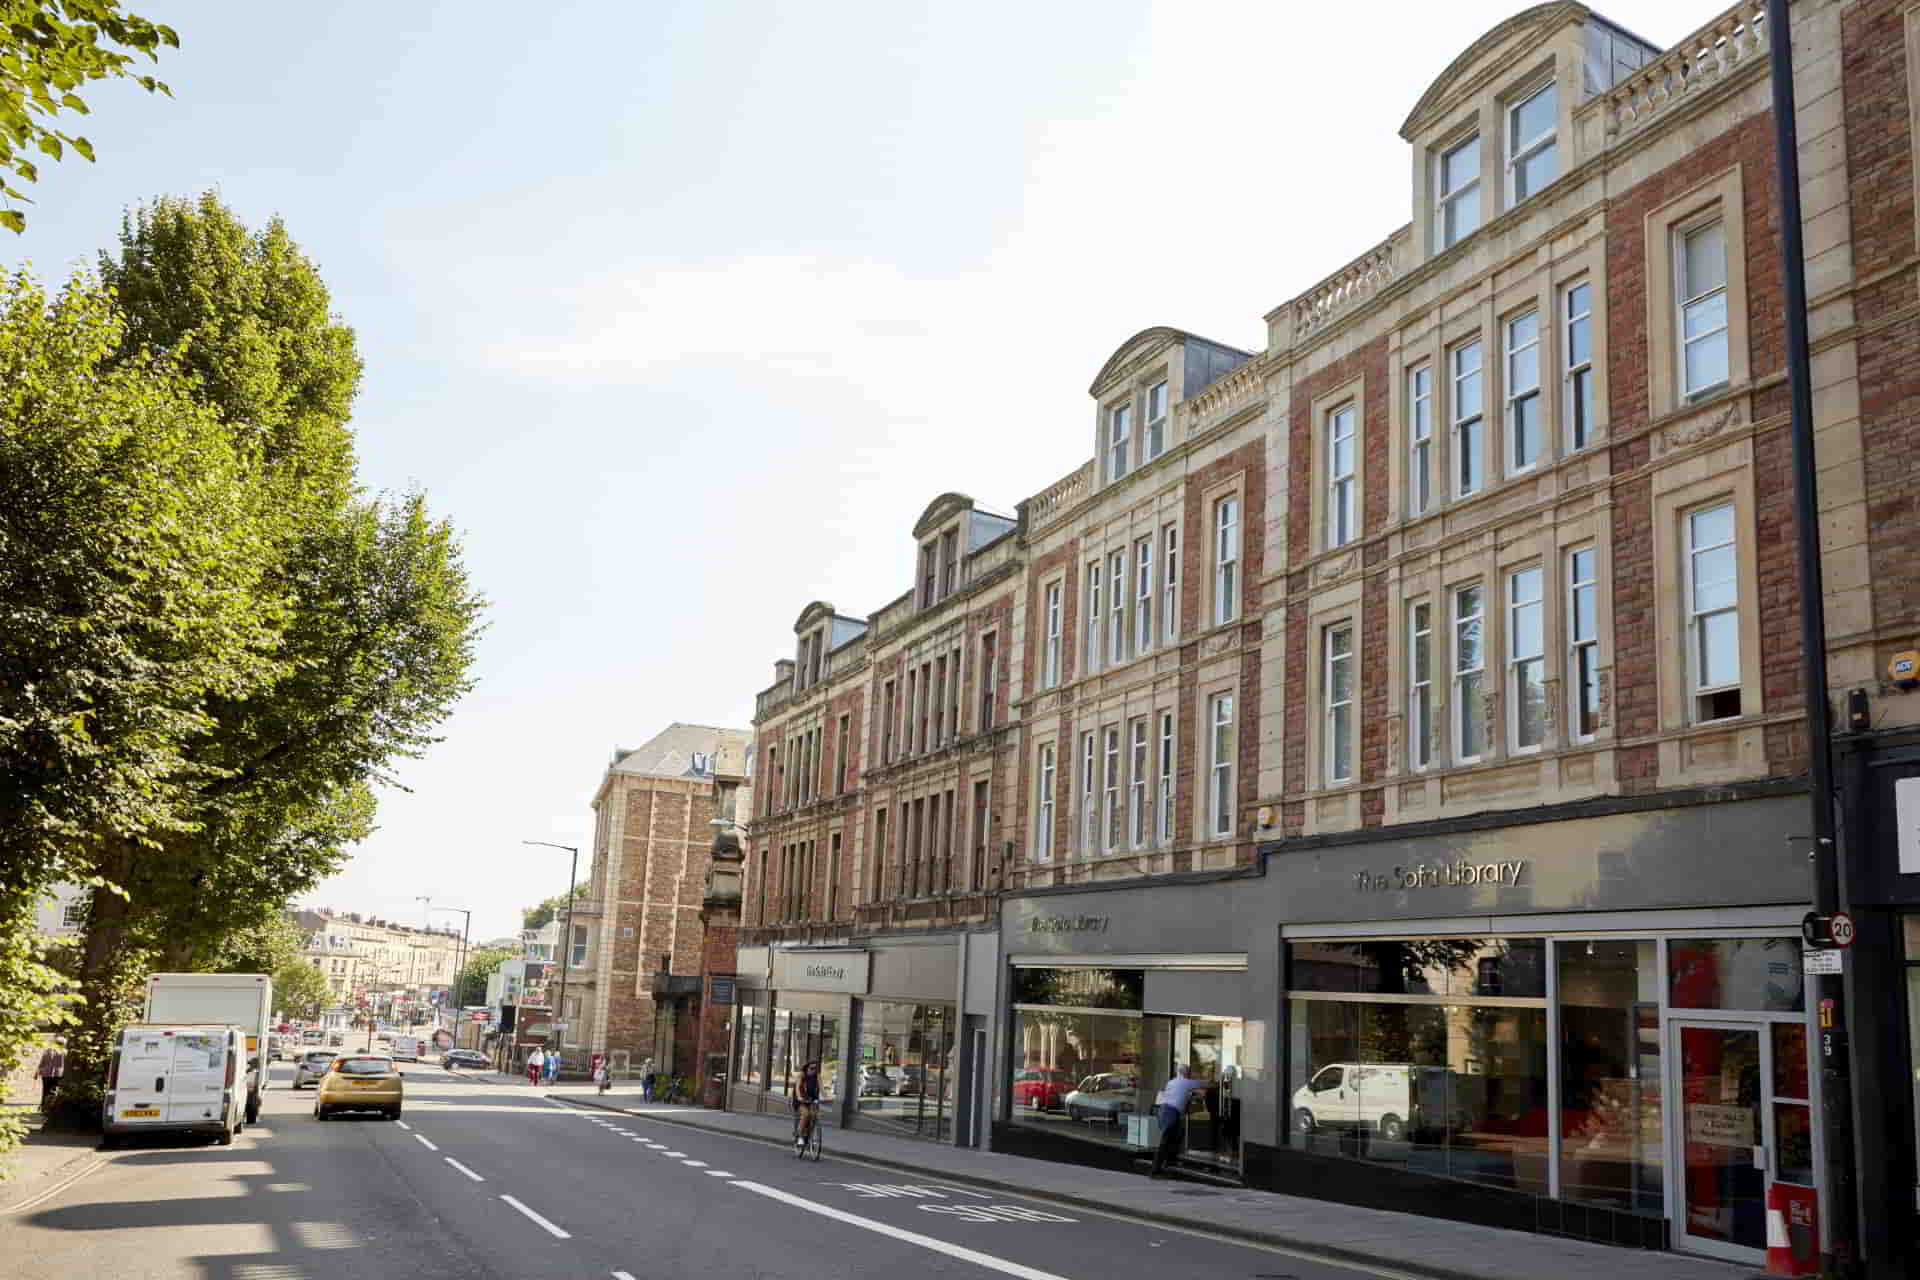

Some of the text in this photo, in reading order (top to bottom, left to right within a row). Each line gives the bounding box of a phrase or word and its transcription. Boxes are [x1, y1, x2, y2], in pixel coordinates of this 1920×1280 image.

[1394, 863, 1440, 889] Sofa
[1447, 858, 1525, 888] Library
[1834, 922, 1852, 937] 20
